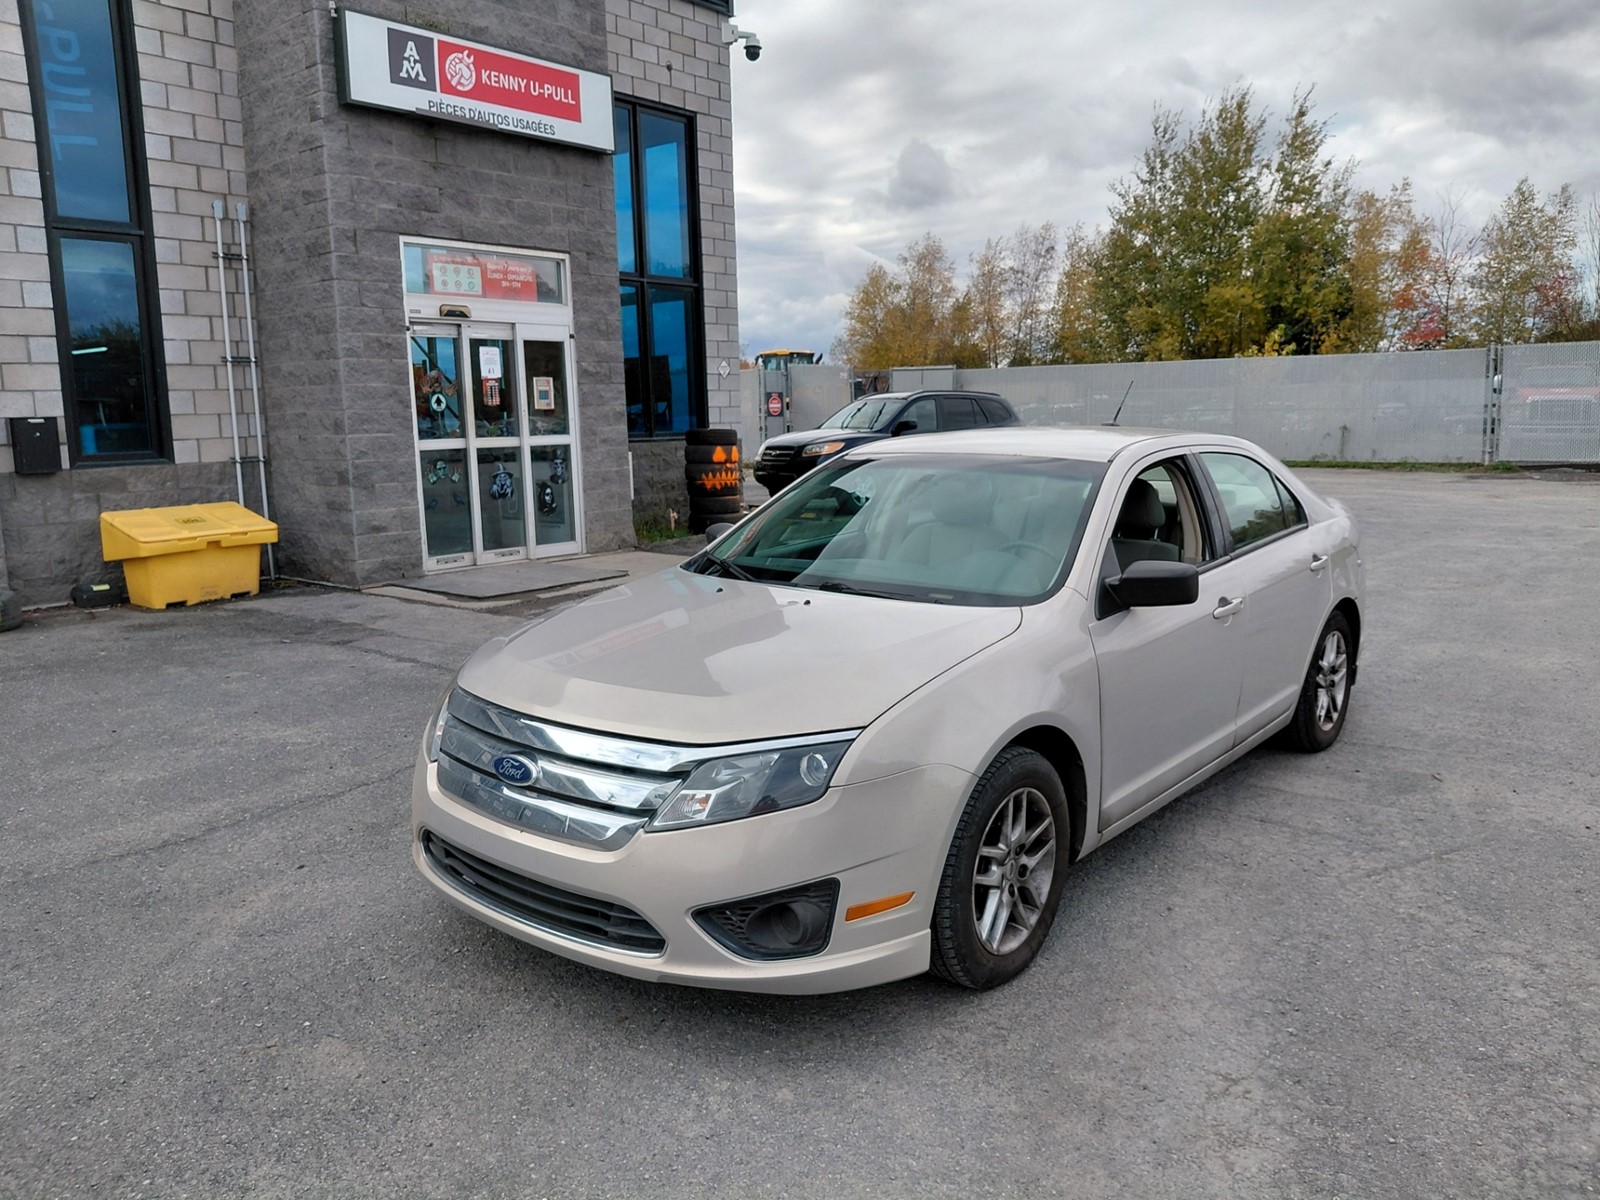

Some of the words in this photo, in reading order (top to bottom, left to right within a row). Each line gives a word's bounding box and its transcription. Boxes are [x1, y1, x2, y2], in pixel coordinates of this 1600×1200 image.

[481, 69, 527, 93] KENNY
[529, 81, 576, 105] U-PULL
[428, 98, 467, 119] PIÈCES
[468, 107, 510, 127] D'AUTOS
[512, 117, 556, 136] USAGÉES
[498, 758, 526, 779] Ford
